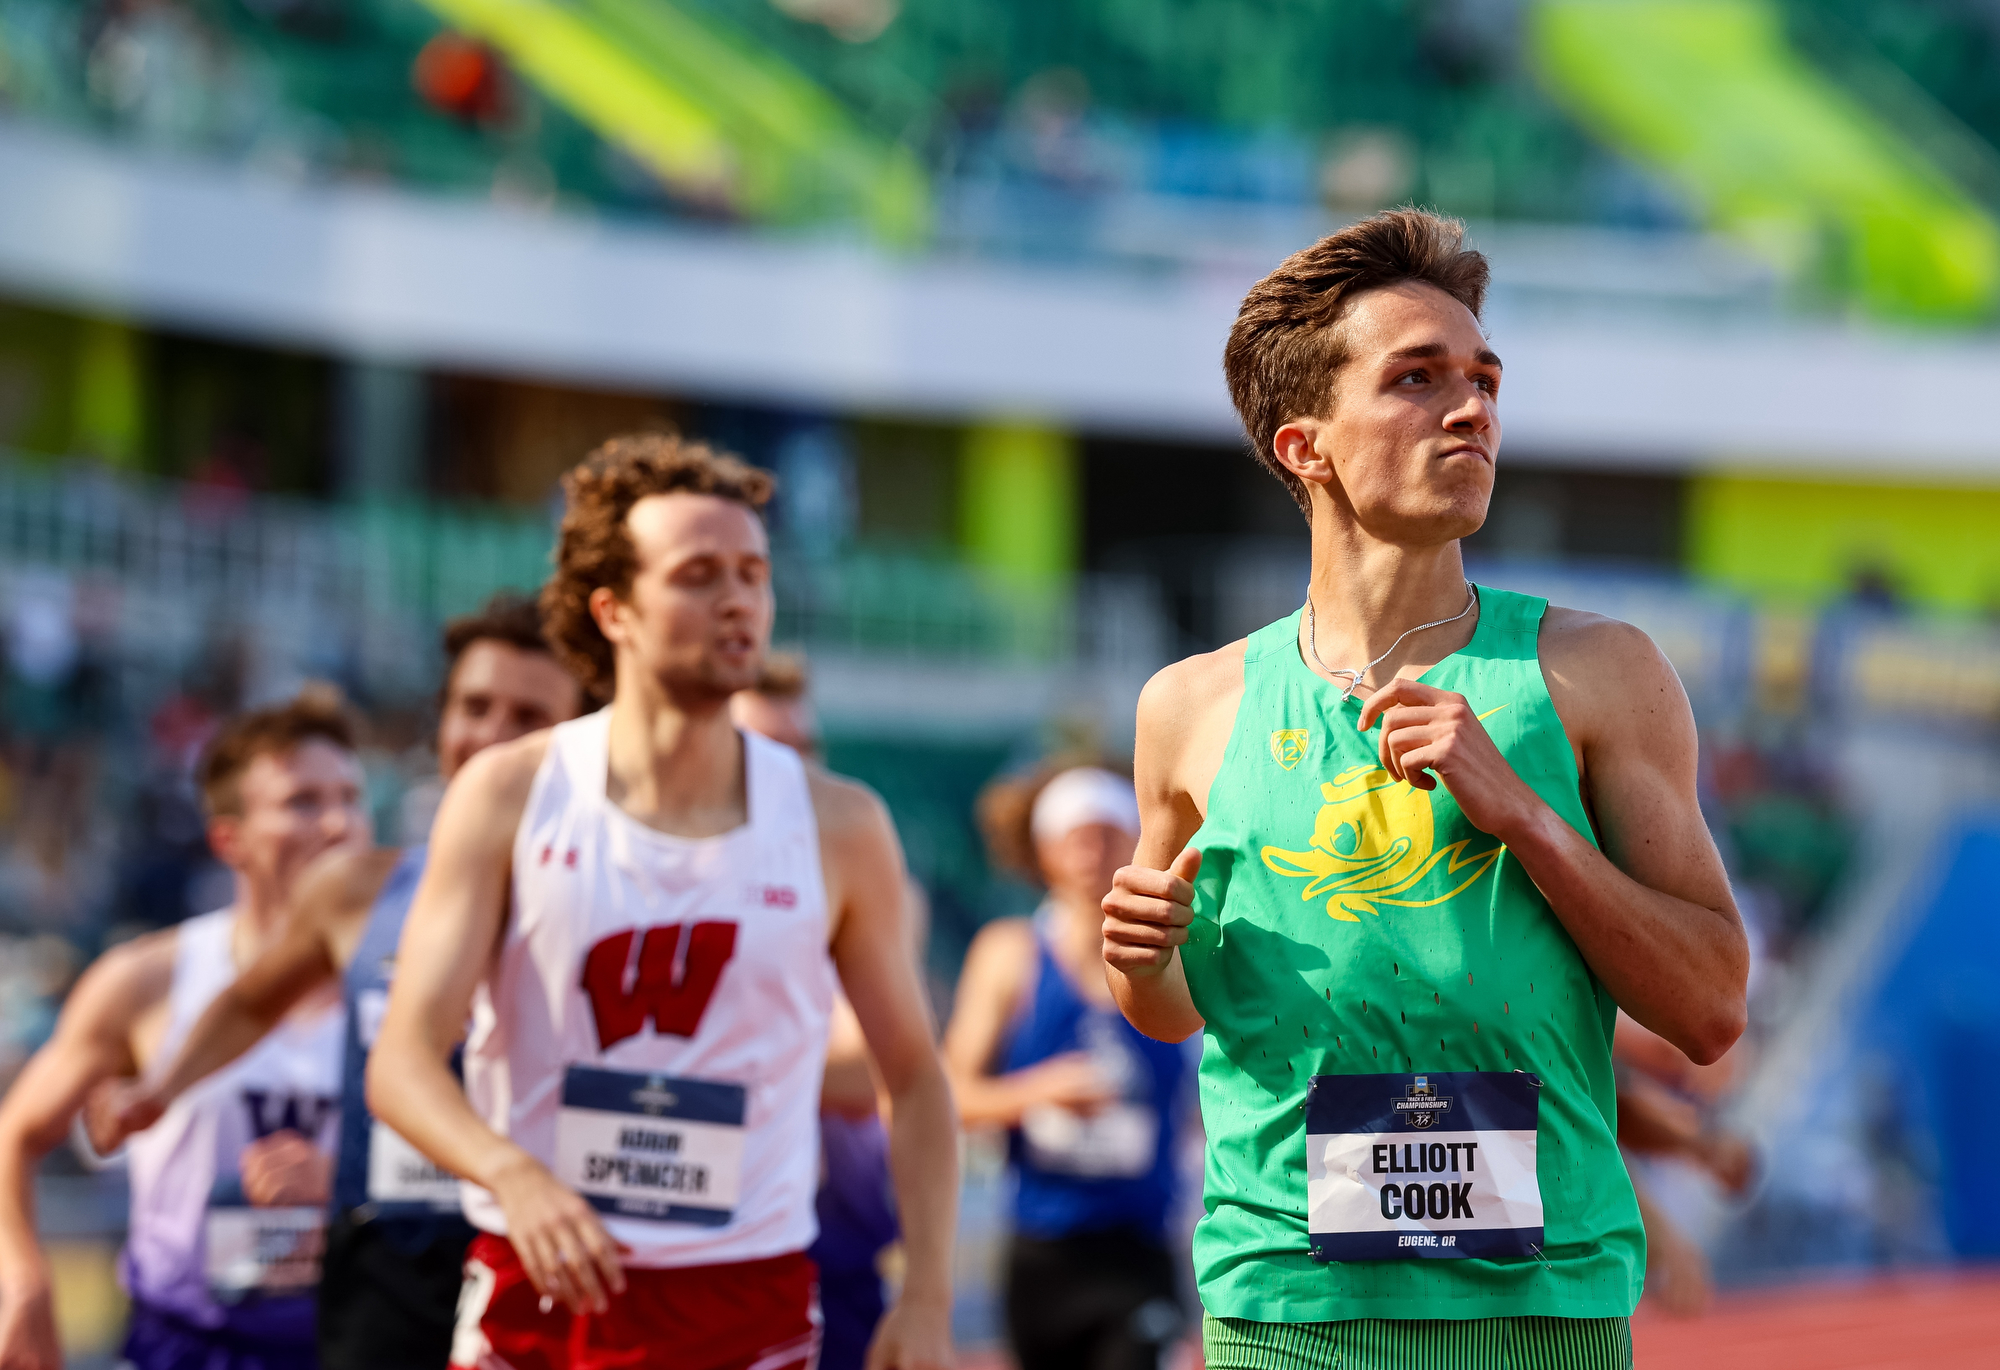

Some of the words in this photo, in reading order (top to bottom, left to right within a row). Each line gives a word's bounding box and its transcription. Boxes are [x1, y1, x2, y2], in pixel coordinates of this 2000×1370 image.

[1280, 746, 1299, 761] 12
[580, 919, 740, 1054] W
[1397, 1101, 1448, 1109] CHAMPIONSHIPS
[1372, 1142, 1478, 1173] ELLIOTT
[585, 1153, 709, 1194] SPENCER
[1380, 1183, 1475, 1220] COOK
[1398, 1235, 1439, 1248] EUGENE,
[1441, 1235, 1456, 1247] OR
